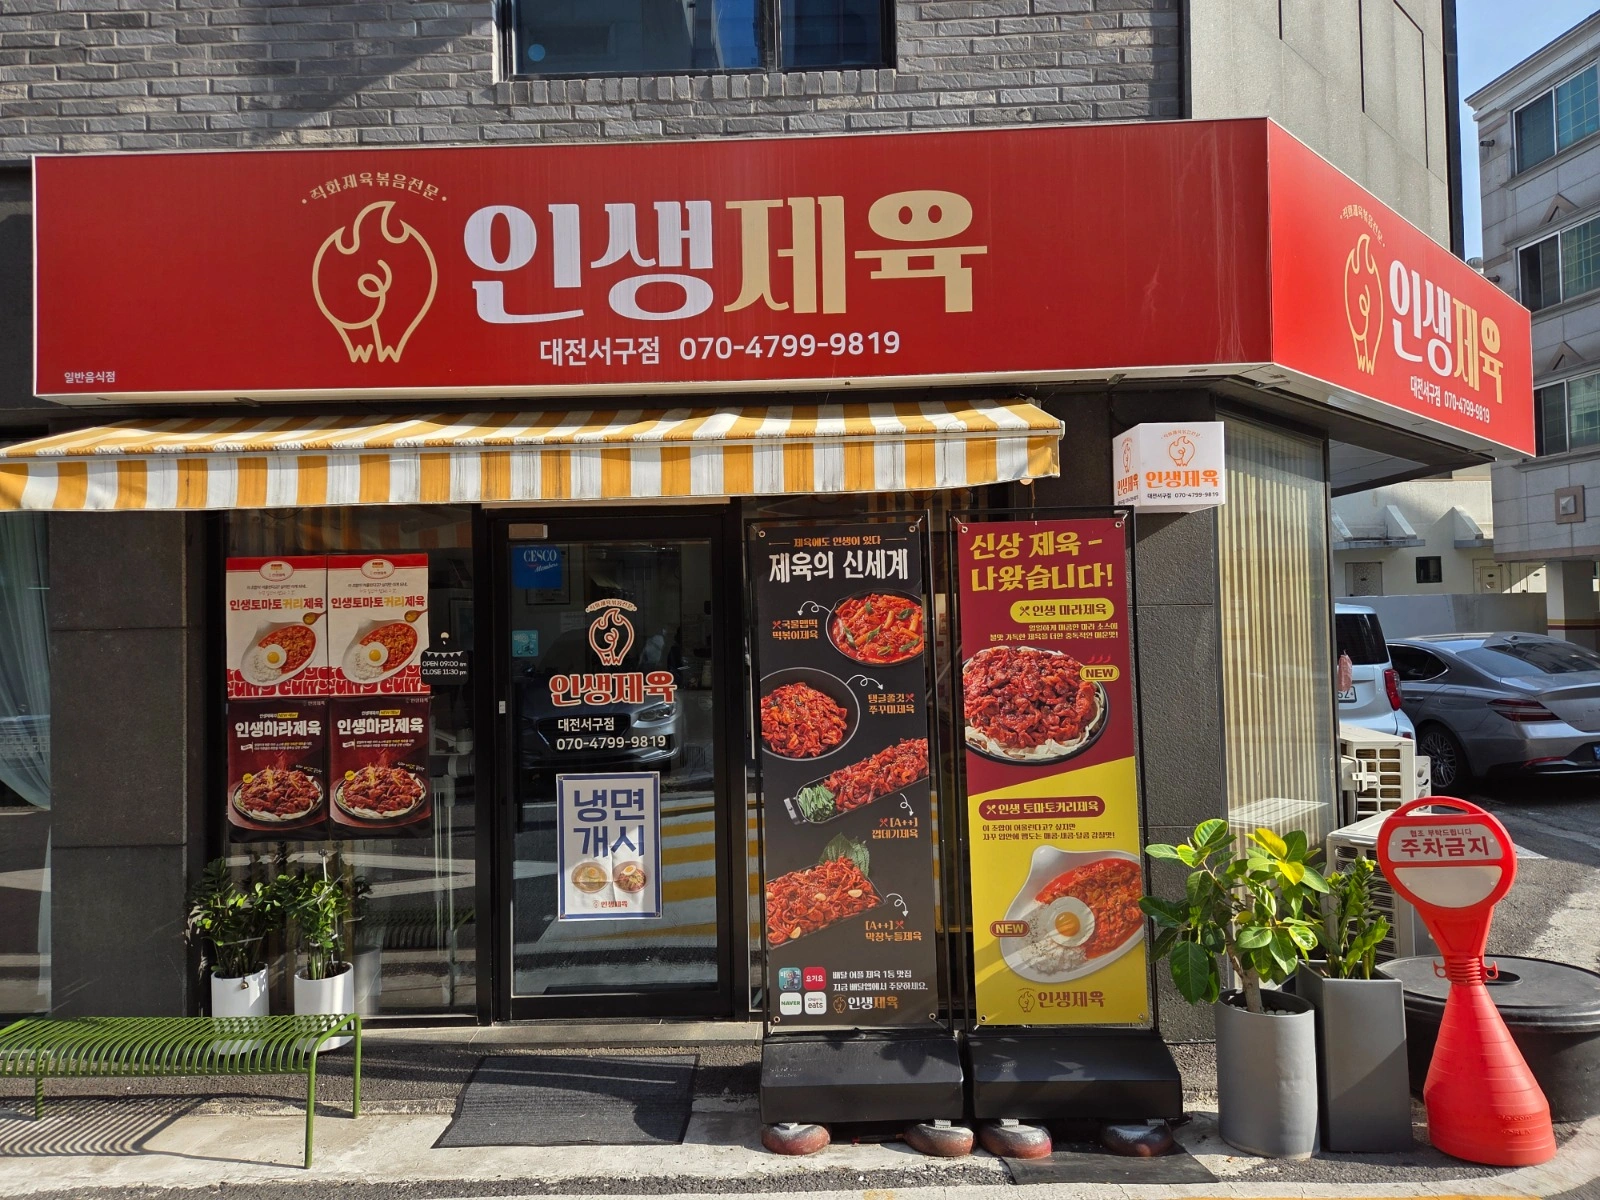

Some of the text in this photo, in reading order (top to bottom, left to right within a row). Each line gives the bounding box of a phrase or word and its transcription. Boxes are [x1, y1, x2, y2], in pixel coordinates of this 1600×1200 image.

[309, 172, 440, 201] 직화제육볶음전문
[463, 189, 988, 324] 인생제육
[1389, 259, 1504, 404] 인생제육
[540, 331, 900, 367] 대전서구점 070-4799-9819
[64, 370, 116, 384] 일반음식점
[1410, 375, 1490, 424] 대전서구점 070-4799-9819
[1145, 469, 1220, 489] 인생제육
[793, 535, 881, 548] 제육에도 인생이 있다
[969, 532, 1024, 560] 신상
[1028, 530, 1082, 558] 제육
[523, 549, 557, 562] CESCO
[768, 548, 909, 584] 제육의 신세계
[971, 562, 1113, 592] 나왔습니다!
[229, 597, 324, 611] 인생토마토커리제육
[330, 595, 426, 609] 인생토마토커리제육
[1032, 603, 1107, 617] 인생 마라제육
[772, 629, 819, 641] 떡볶이제육
[1085, 668, 1114, 678] NEW
[550, 671, 677, 707] 인생제육
[868, 704, 915, 715] 쭈꾸미제육
[234, 719, 322, 738] 인생마라제육
[336, 717, 424, 736] 인생마라제육
[557, 717, 615, 732] 대전서구점
[556, 735, 667, 751] 070-4799-9819
[573, 788, 646, 823] 냉면
[997, 801, 1099, 814] 인생 토마토커리제육
[889, 817, 918, 828] [A++]
[992, 824, 1012, 832] 조합이
[871, 829, 919, 839] 껍데기제육
[1409, 828, 1473, 837] 협조 부탁드립니다
[573, 824, 645, 858] 개시
[1400, 836, 1490, 858] 주차금지
[865, 920, 894, 931] [A++]
[995, 923, 1024, 934] NEW
[865, 931, 923, 942] 막창누들제육
[805, 974, 824, 983] 요기요
[832, 969, 912, 980] 배달 어플 제육 1등 맛집
[833, 981, 929, 991] 지금 배달앱에서 주문하세요.
[807, 1001, 824, 1009] eats
[847, 995, 899, 1010] 인생제육
[1037, 990, 1106, 1008] 인생제육
